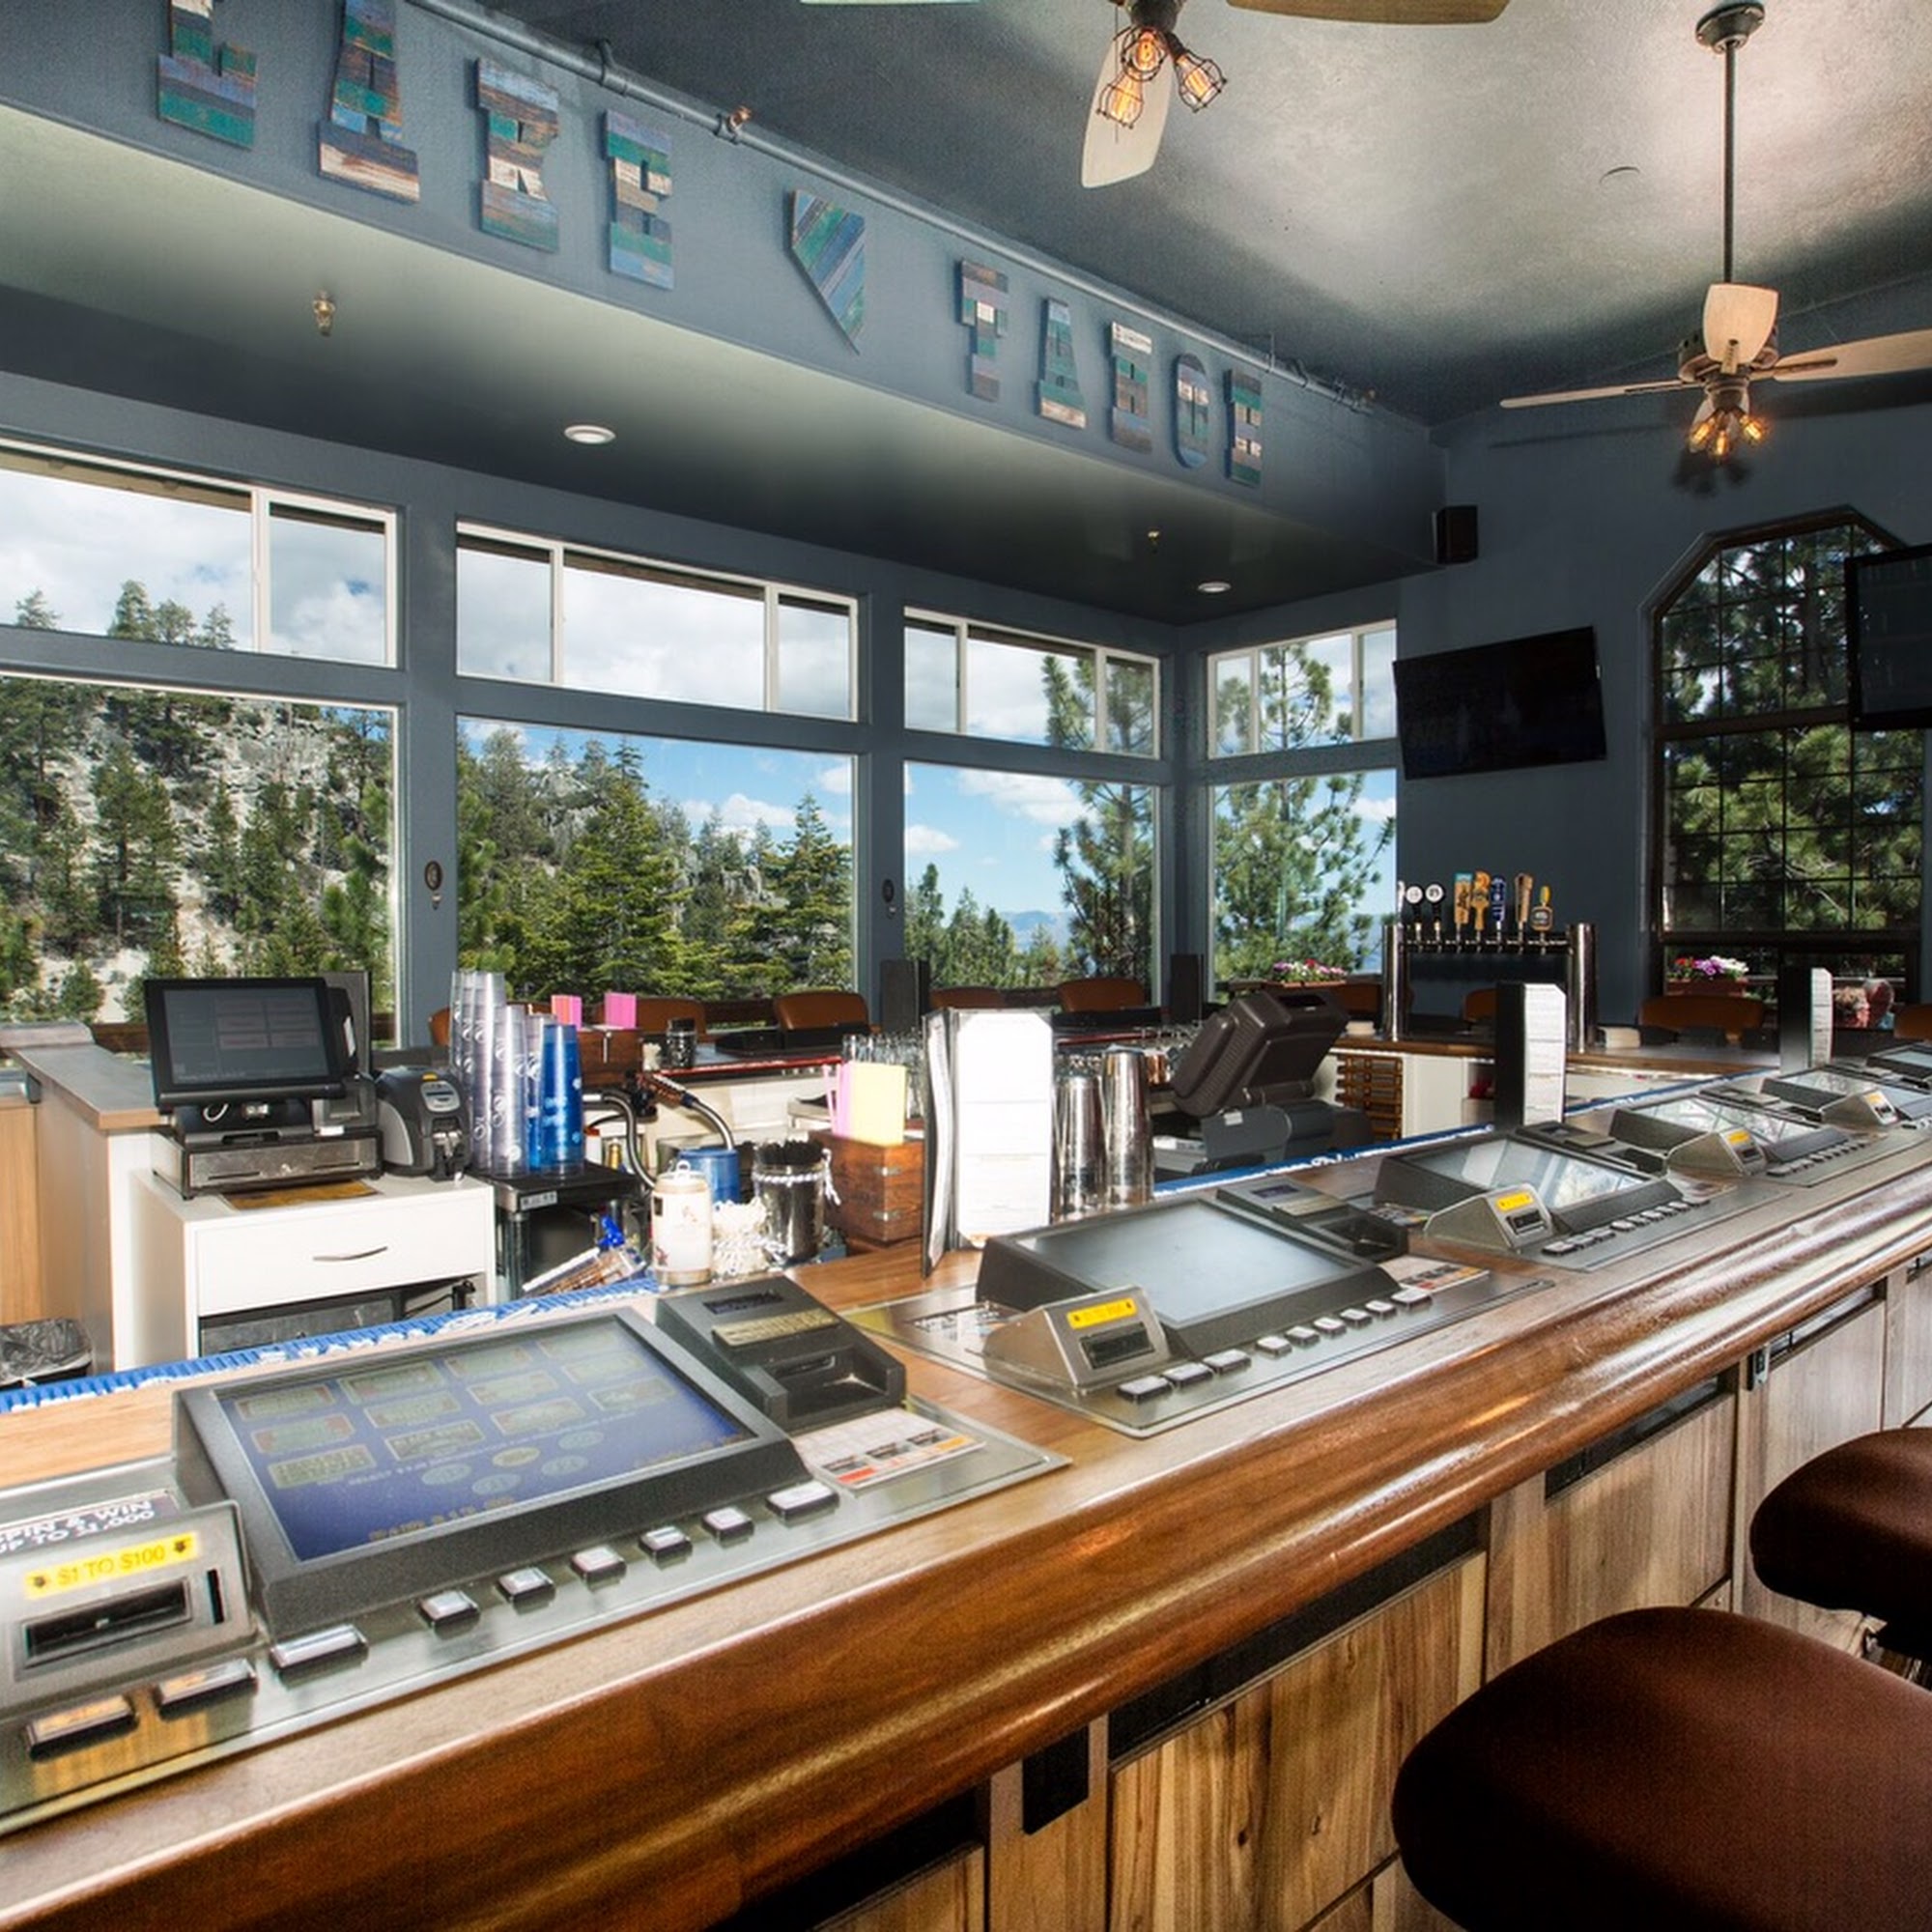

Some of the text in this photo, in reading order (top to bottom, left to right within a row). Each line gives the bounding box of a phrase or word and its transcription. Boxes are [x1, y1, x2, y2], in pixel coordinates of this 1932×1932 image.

[156, 0, 1264, 489] LAKE TAHOE
[94, 1499, 154, 1520] WIN
[31, 1528, 70, 1546] TO
[57, 1545, 167, 1587] $1 TO $100
